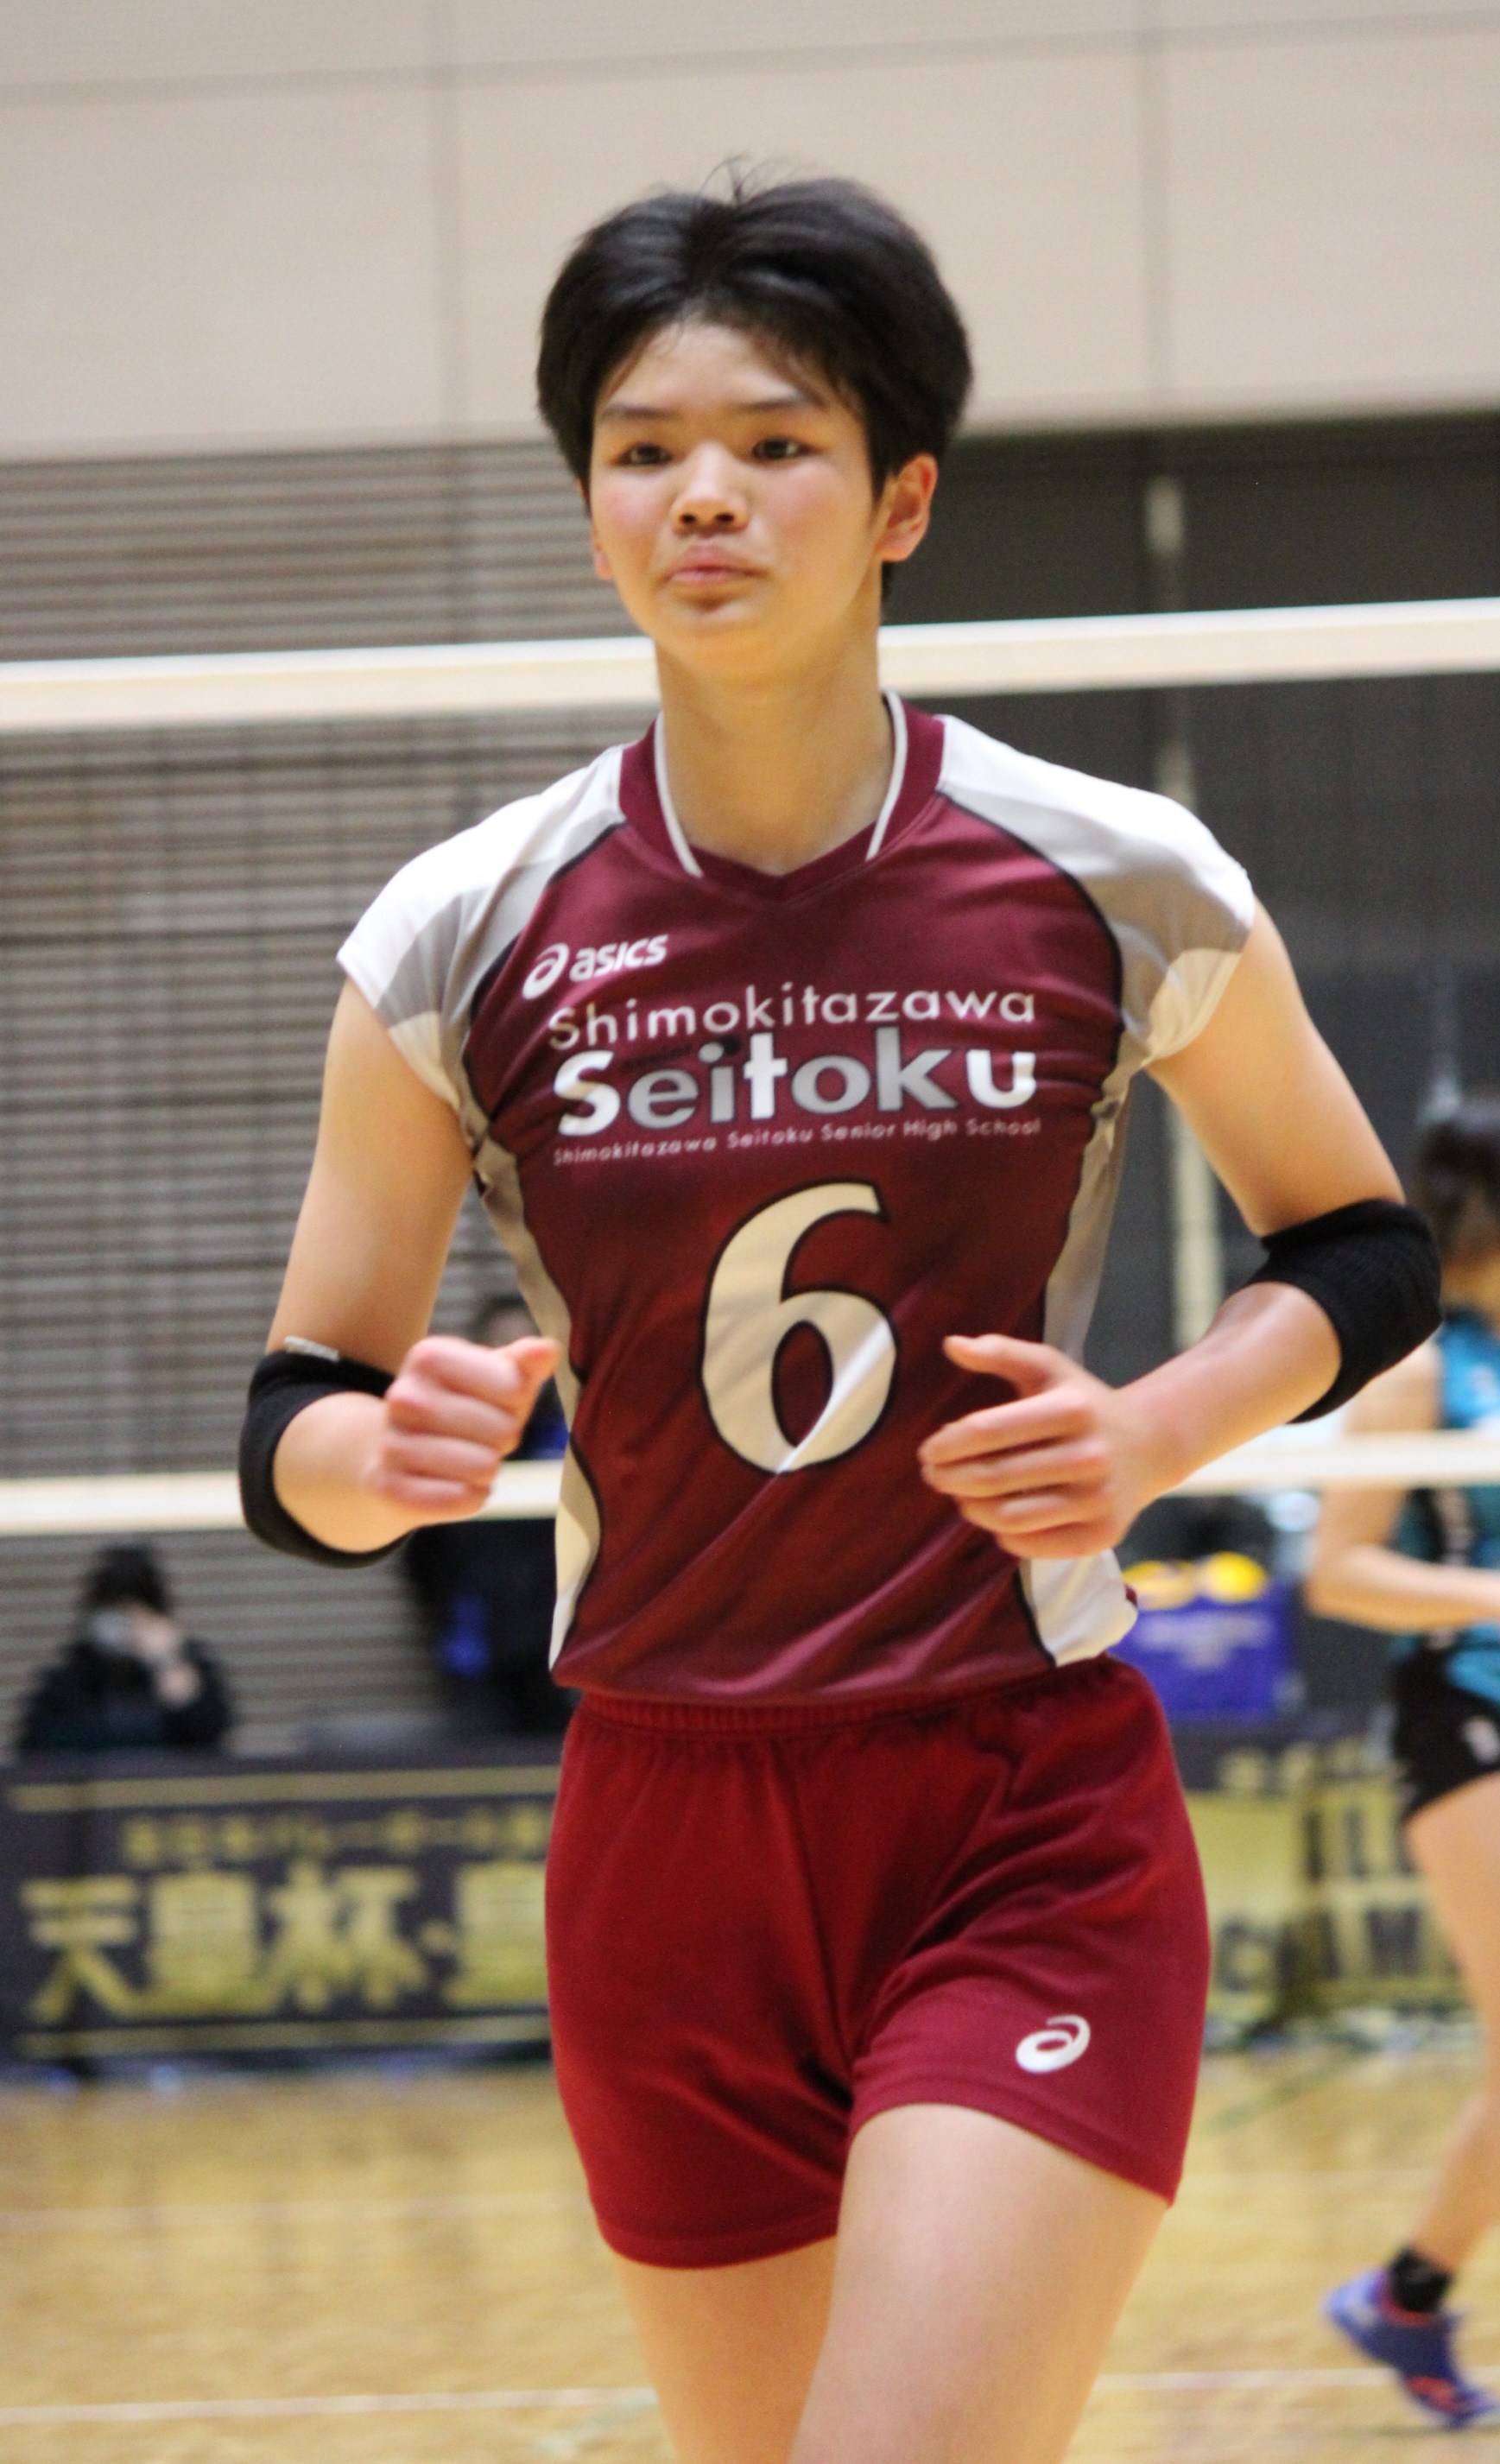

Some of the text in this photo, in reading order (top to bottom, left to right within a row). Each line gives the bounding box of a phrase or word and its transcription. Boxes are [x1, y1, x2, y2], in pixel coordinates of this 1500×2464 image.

[568, 934, 669, 983] asics
[547, 981, 1036, 1050] Shimokitazawa
[553, 1026, 1038, 1137] Seitoku
[821, 1123, 896, 1142] Senior
[903, 1119, 959, 1142] High
[965, 1117, 1041, 1137] School
[700, 1178, 898, 1476] 6
